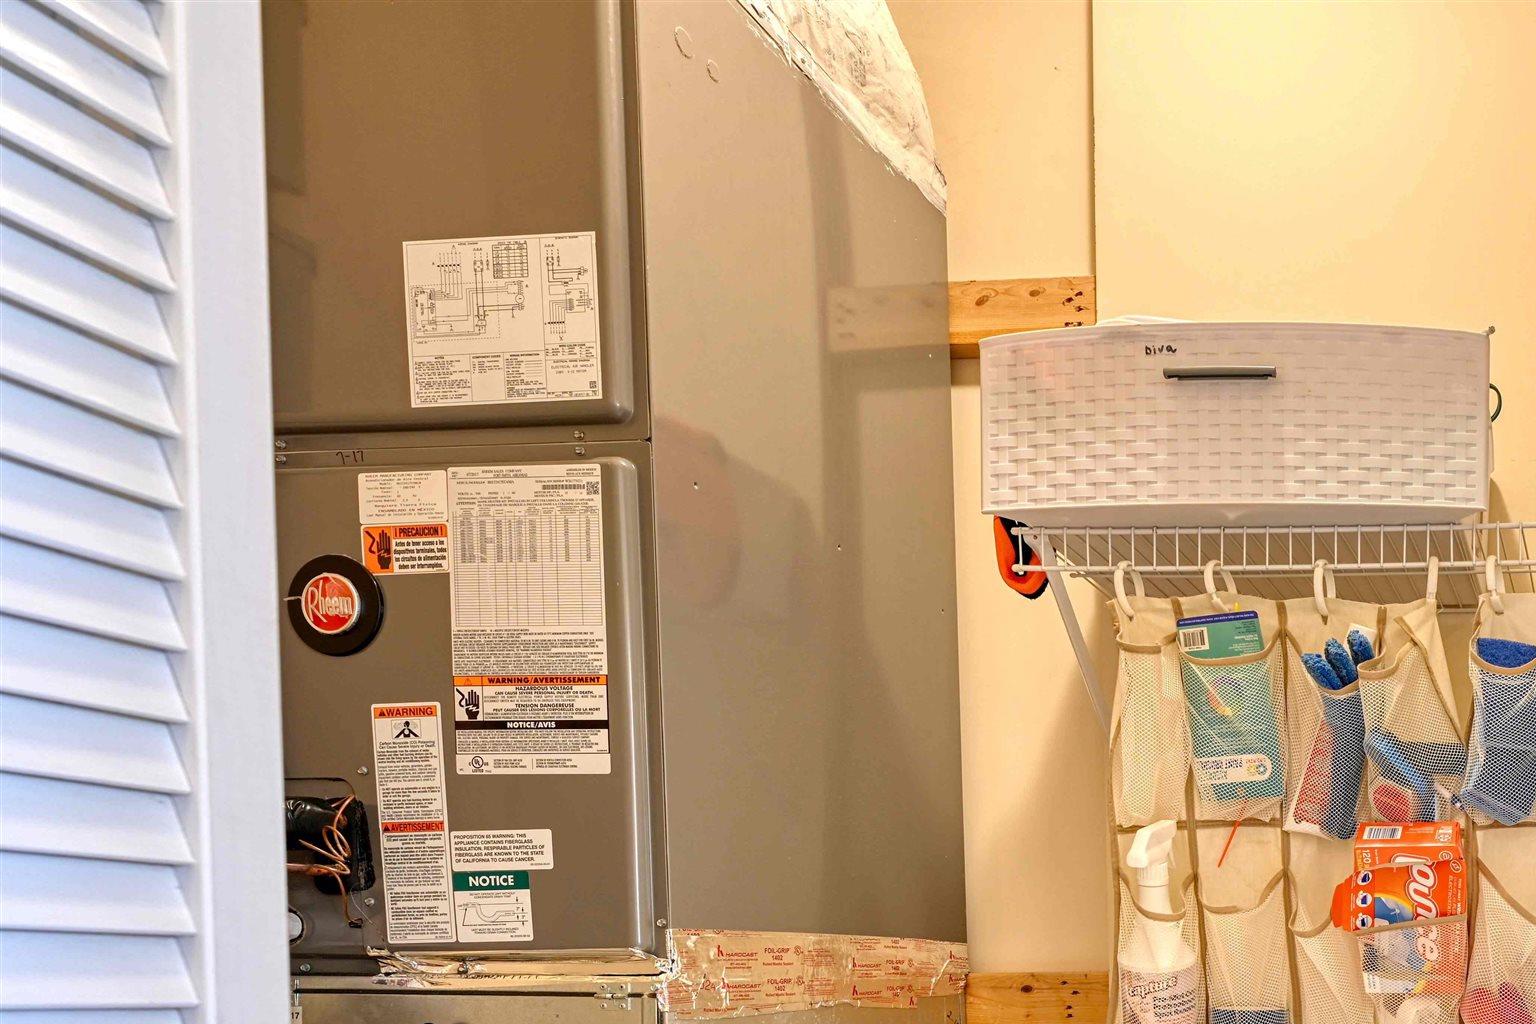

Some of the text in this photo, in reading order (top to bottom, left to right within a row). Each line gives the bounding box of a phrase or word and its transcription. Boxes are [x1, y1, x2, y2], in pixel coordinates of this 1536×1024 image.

[308, 580, 354, 623] Rheem
[386, 706, 434, 717] WARNING
[506, 721, 556, 729] NOTICE/AVIS
[391, 823, 444, 832] AVERTISSEMENT
[468, 875, 514, 887] NOTICE
